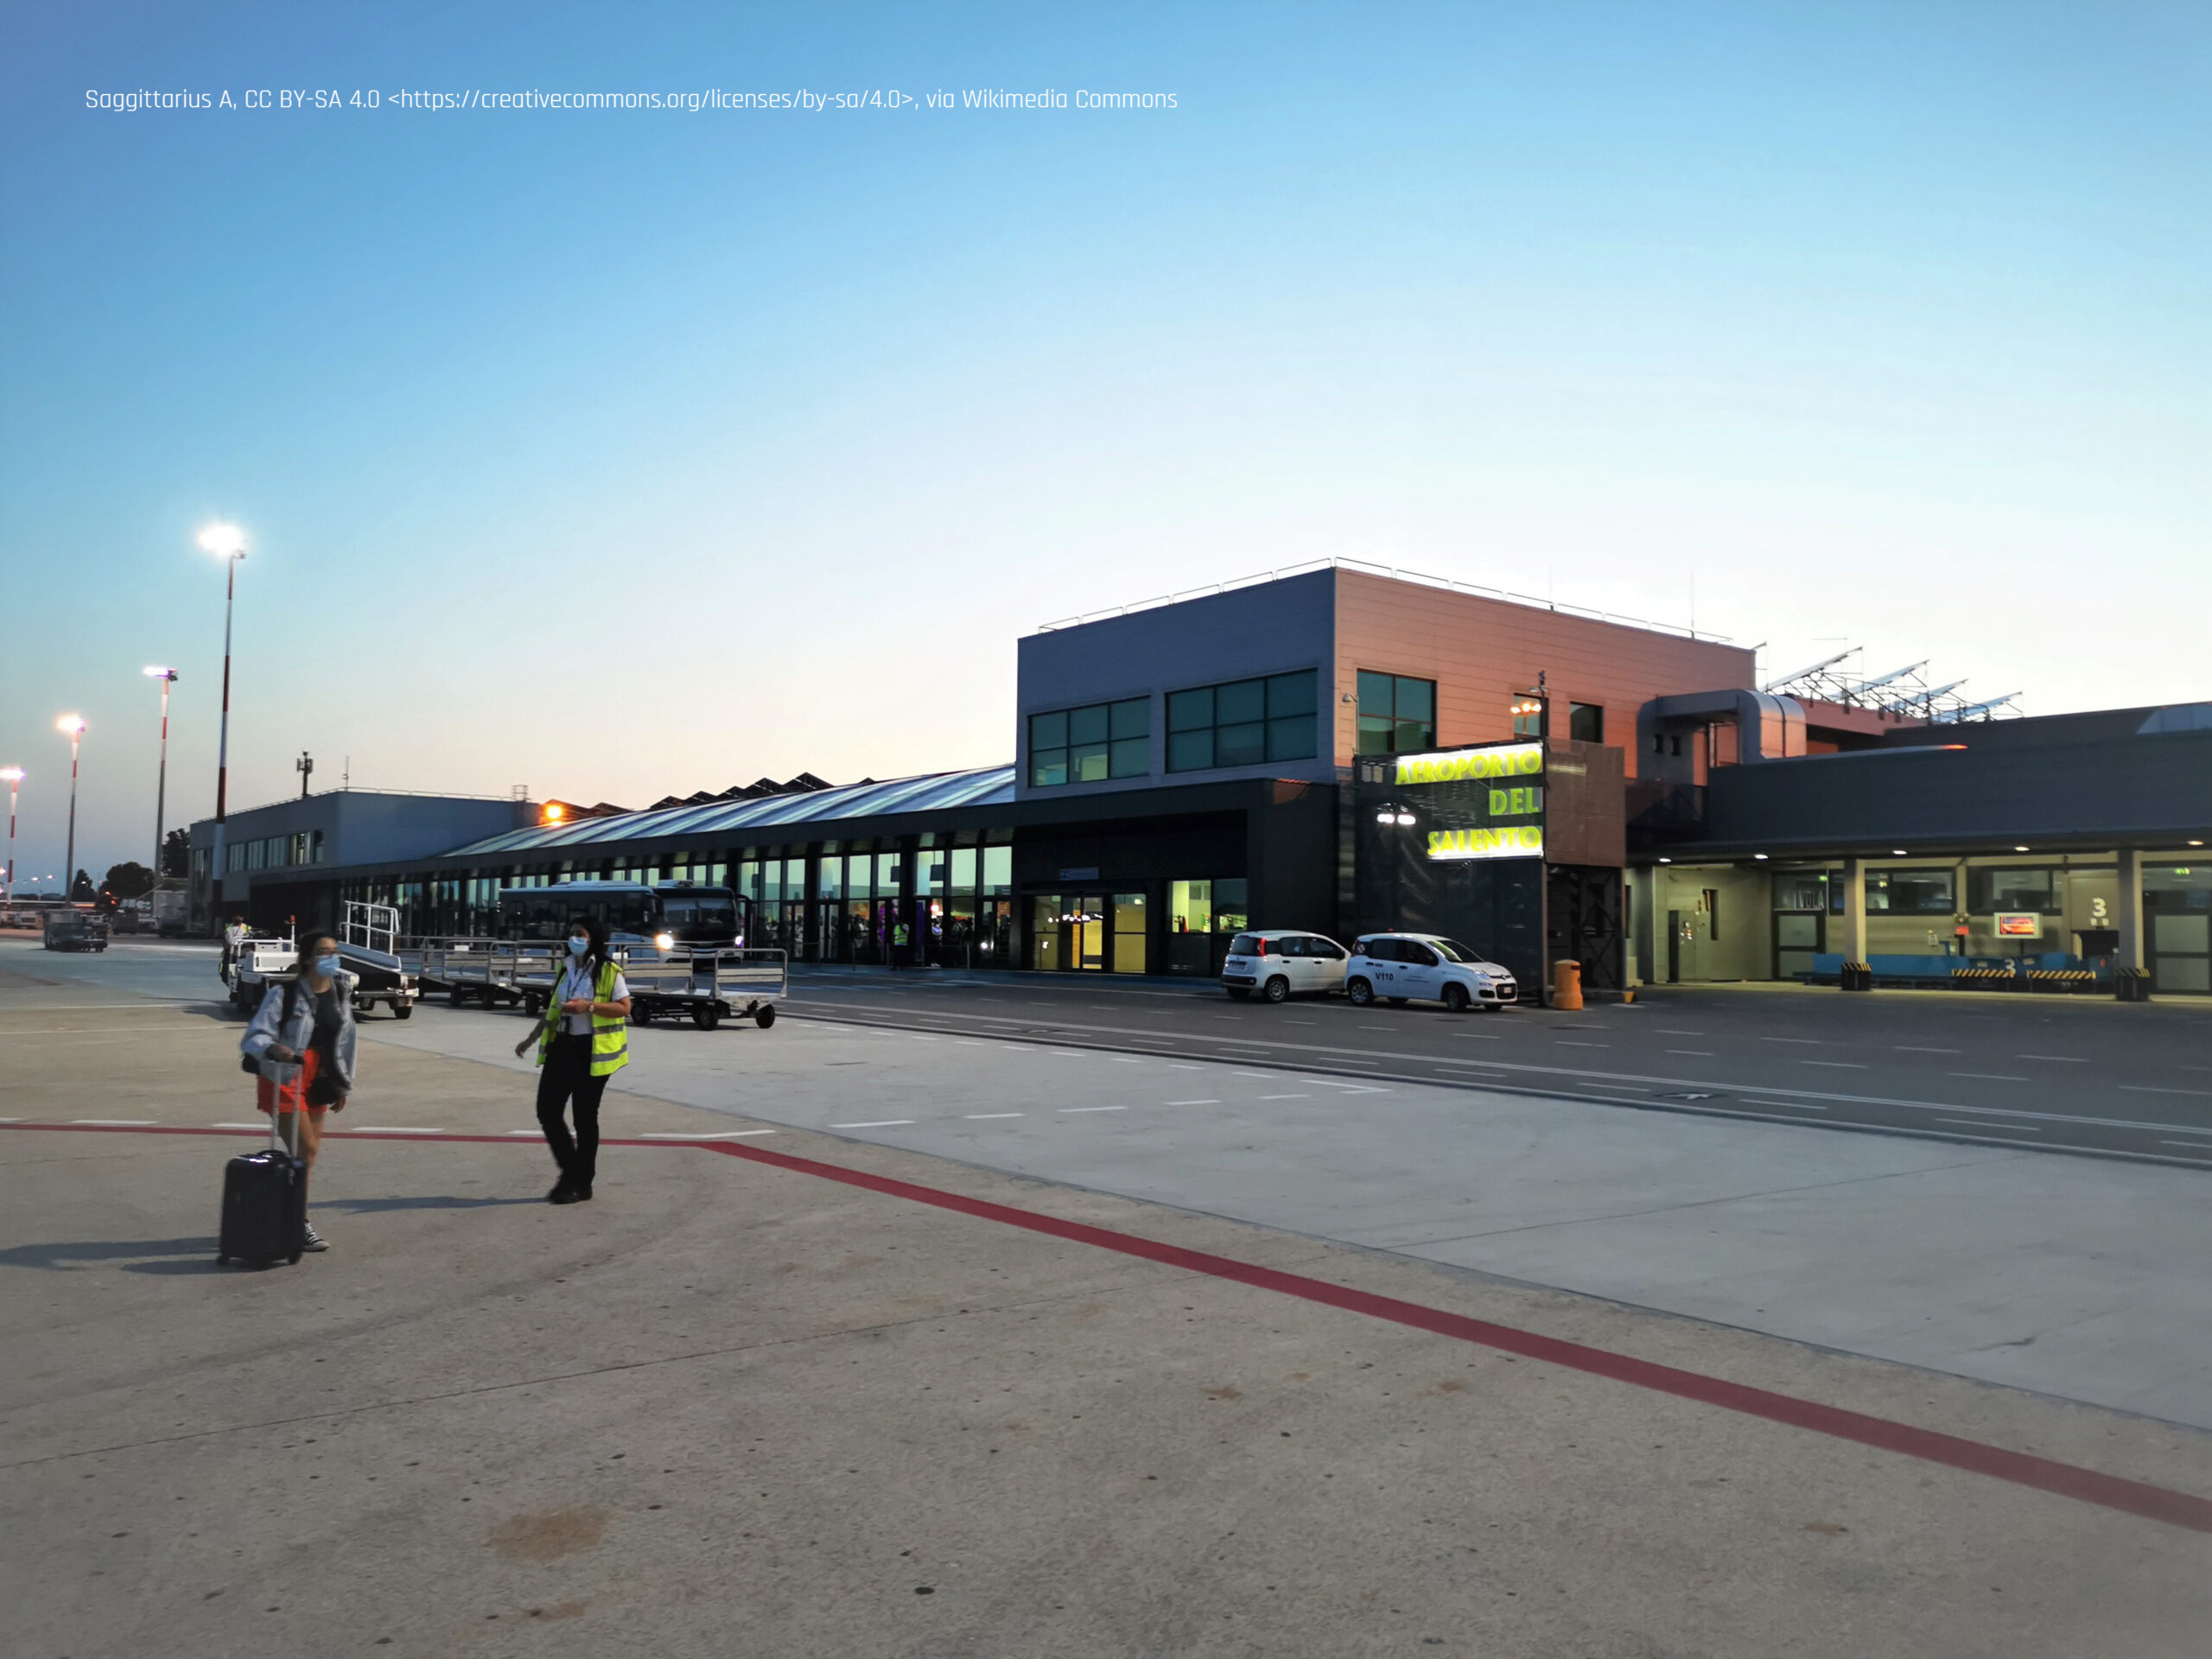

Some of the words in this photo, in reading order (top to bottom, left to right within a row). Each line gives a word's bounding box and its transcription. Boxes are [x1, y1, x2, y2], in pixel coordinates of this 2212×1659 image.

[1395, 750, 1541, 785] AEROPORTO
[1489, 787, 1538, 815] DEL
[1427, 826, 1541, 855] SALENTO
[2092, 897, 2107, 918] 3
[1375, 972, 1394, 982] V110
